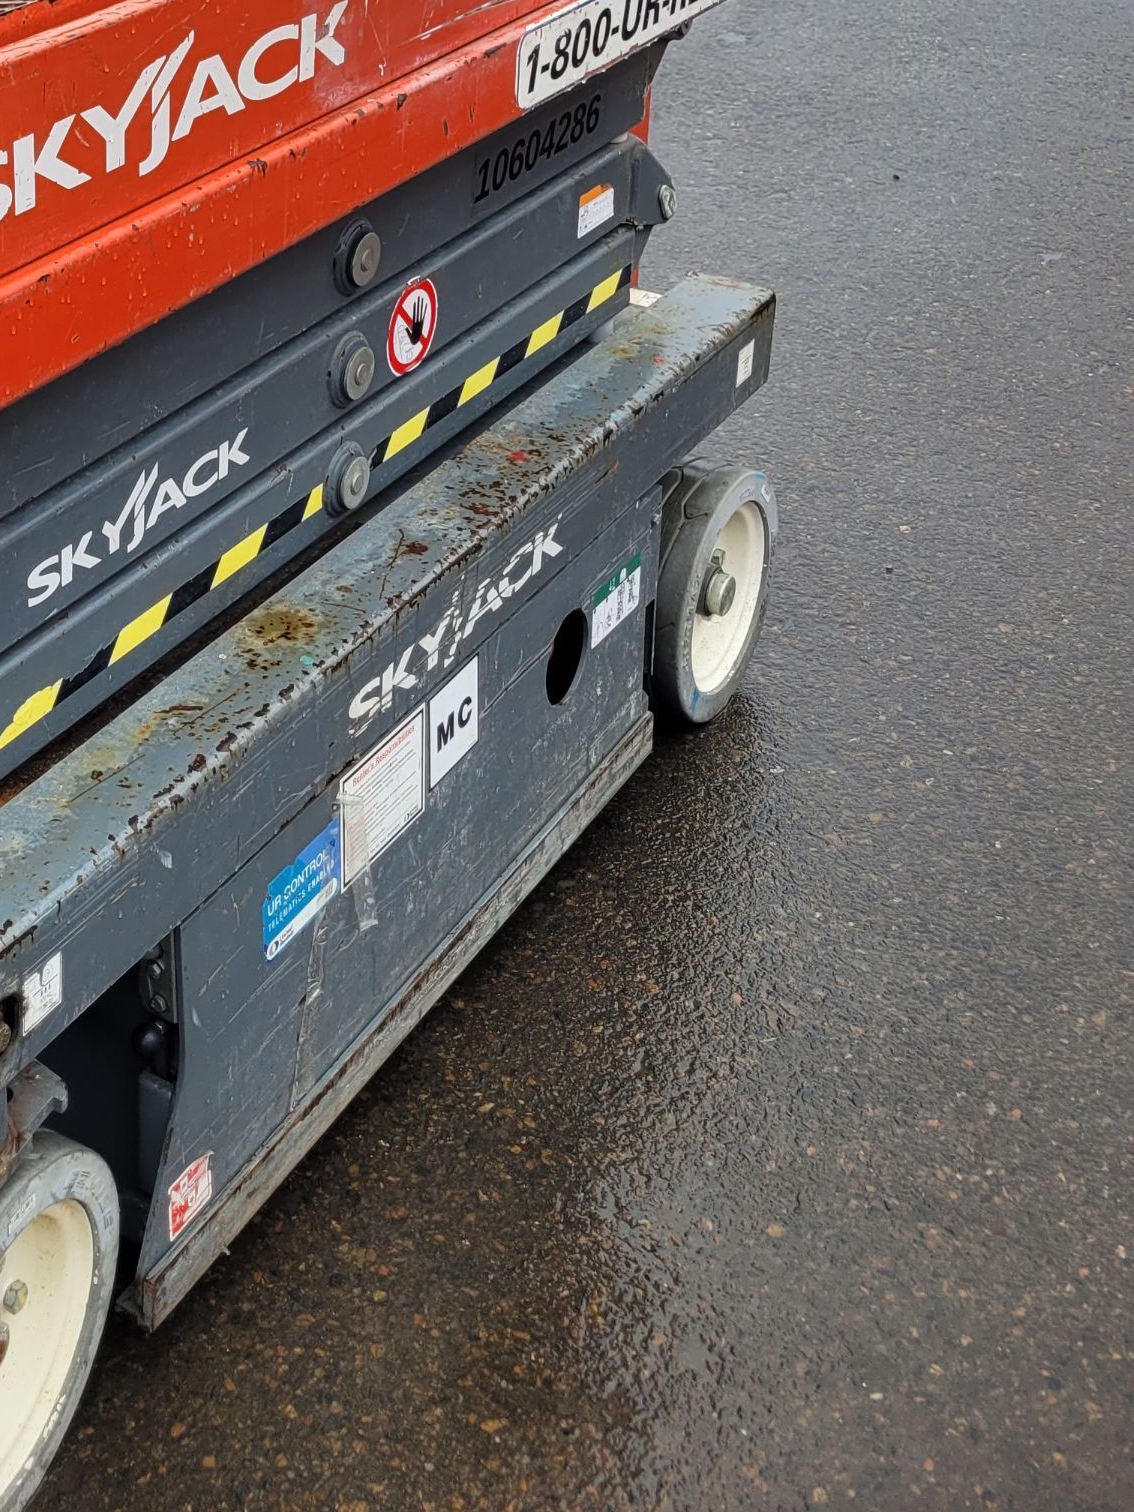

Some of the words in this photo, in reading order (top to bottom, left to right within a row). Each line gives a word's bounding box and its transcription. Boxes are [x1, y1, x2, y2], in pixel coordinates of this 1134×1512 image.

[473, 93, 602, 205] 10604286
[27, 428, 251, 608] SKYJACK
[348, 522, 564, 738] SKYJACK
[267, 894, 282, 917] UR
[283, 849, 330, 900] CONTROL
[268, 889, 306, 932] TELEMATICS
